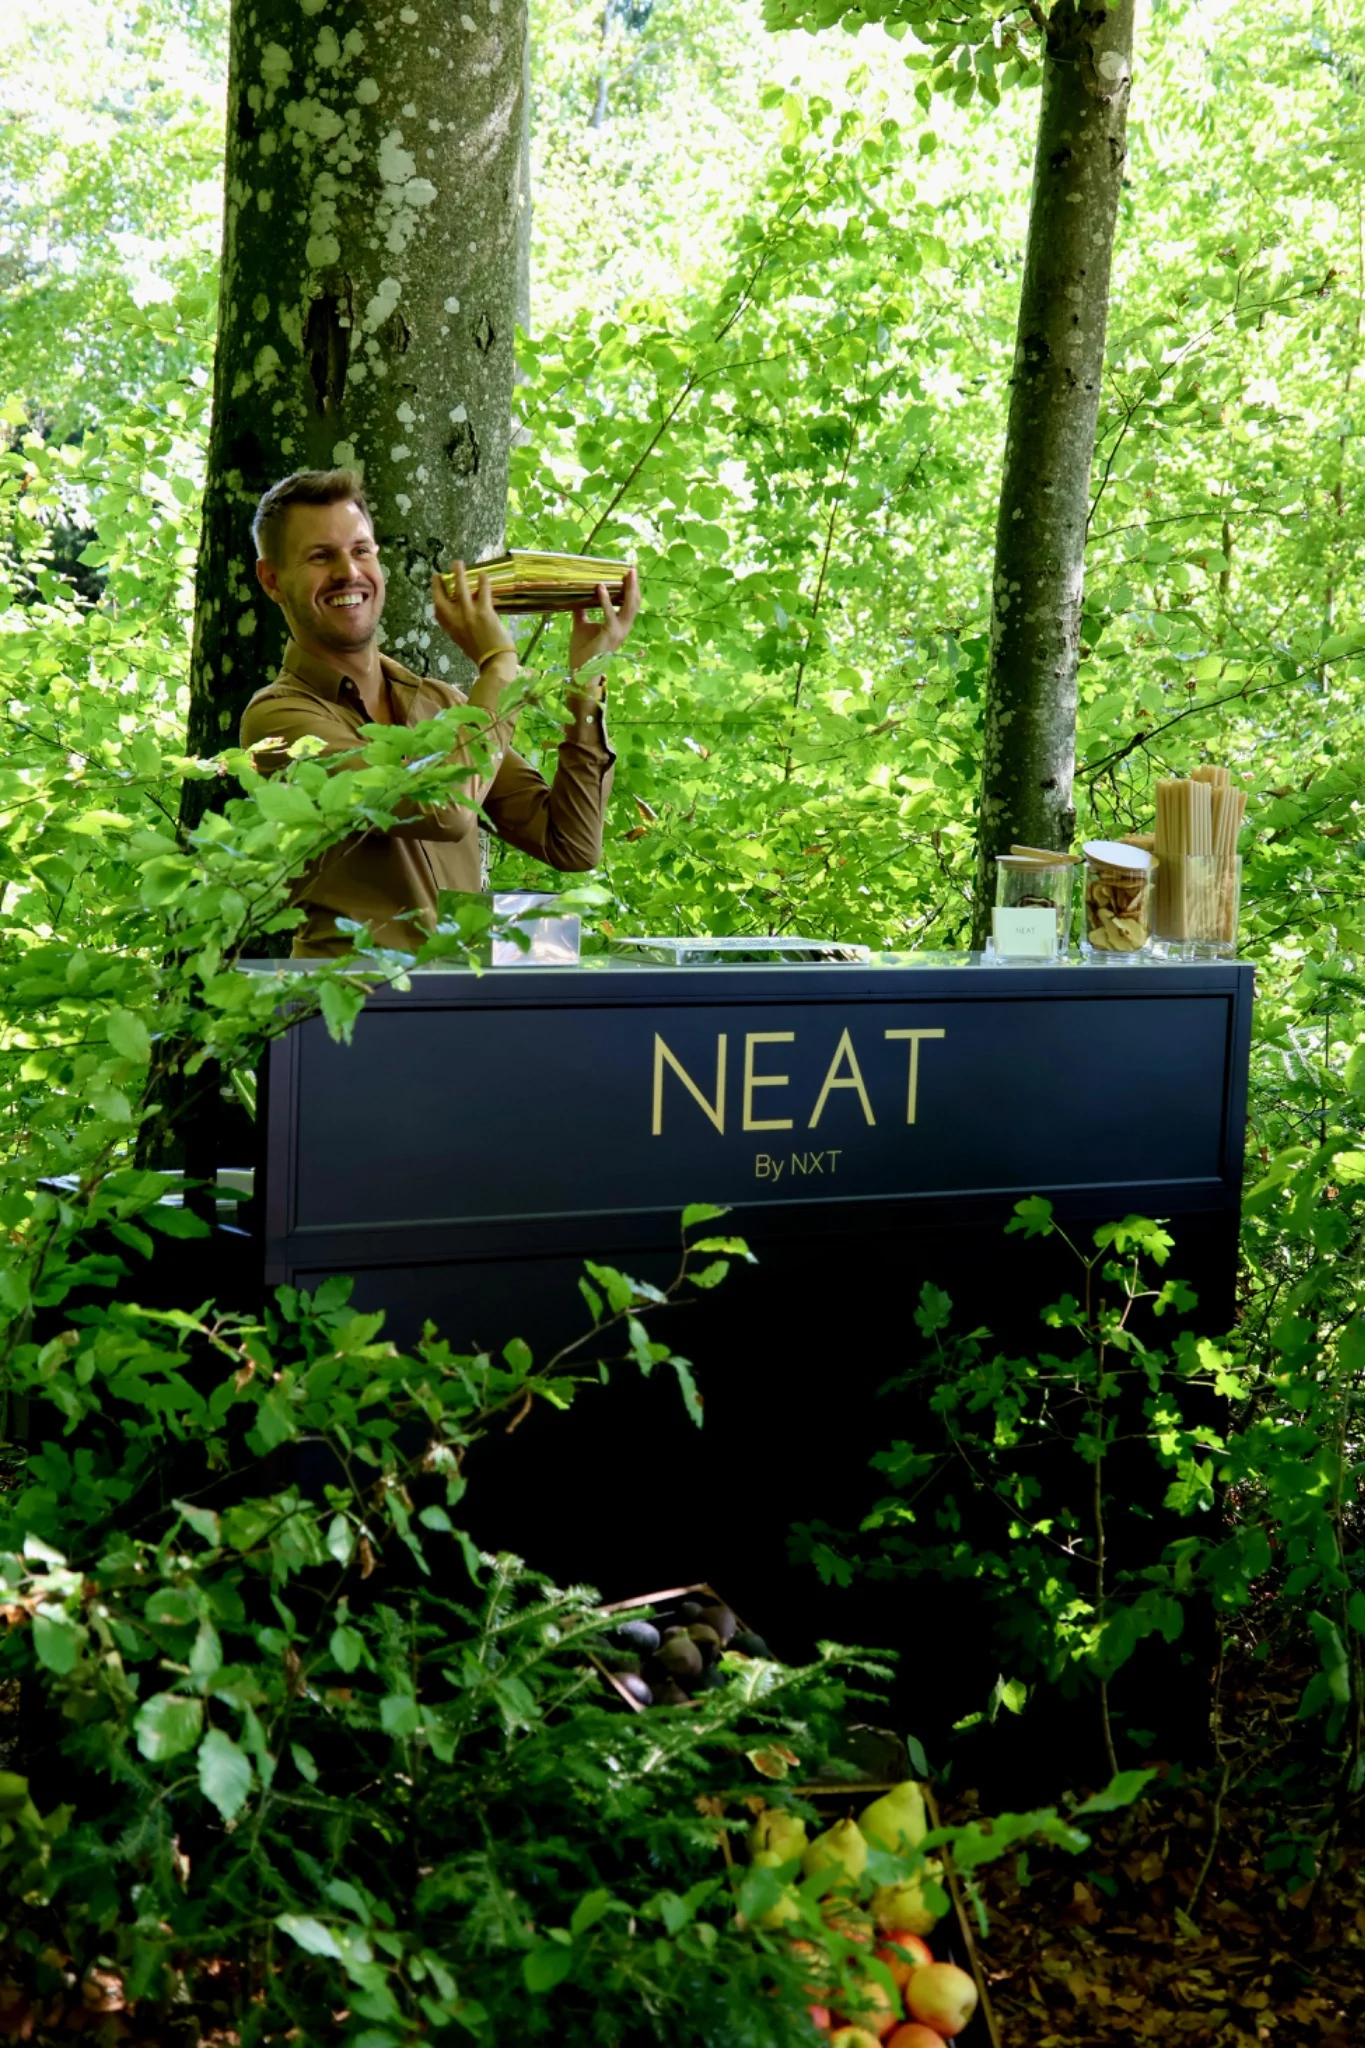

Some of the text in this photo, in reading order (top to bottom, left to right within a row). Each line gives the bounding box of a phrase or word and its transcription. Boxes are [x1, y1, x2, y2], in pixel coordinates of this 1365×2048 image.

[1016, 927, 1036, 935] NEAT
[652, 1027, 945, 1135] NEAT
[755, 1150, 843, 1182] By NXT
